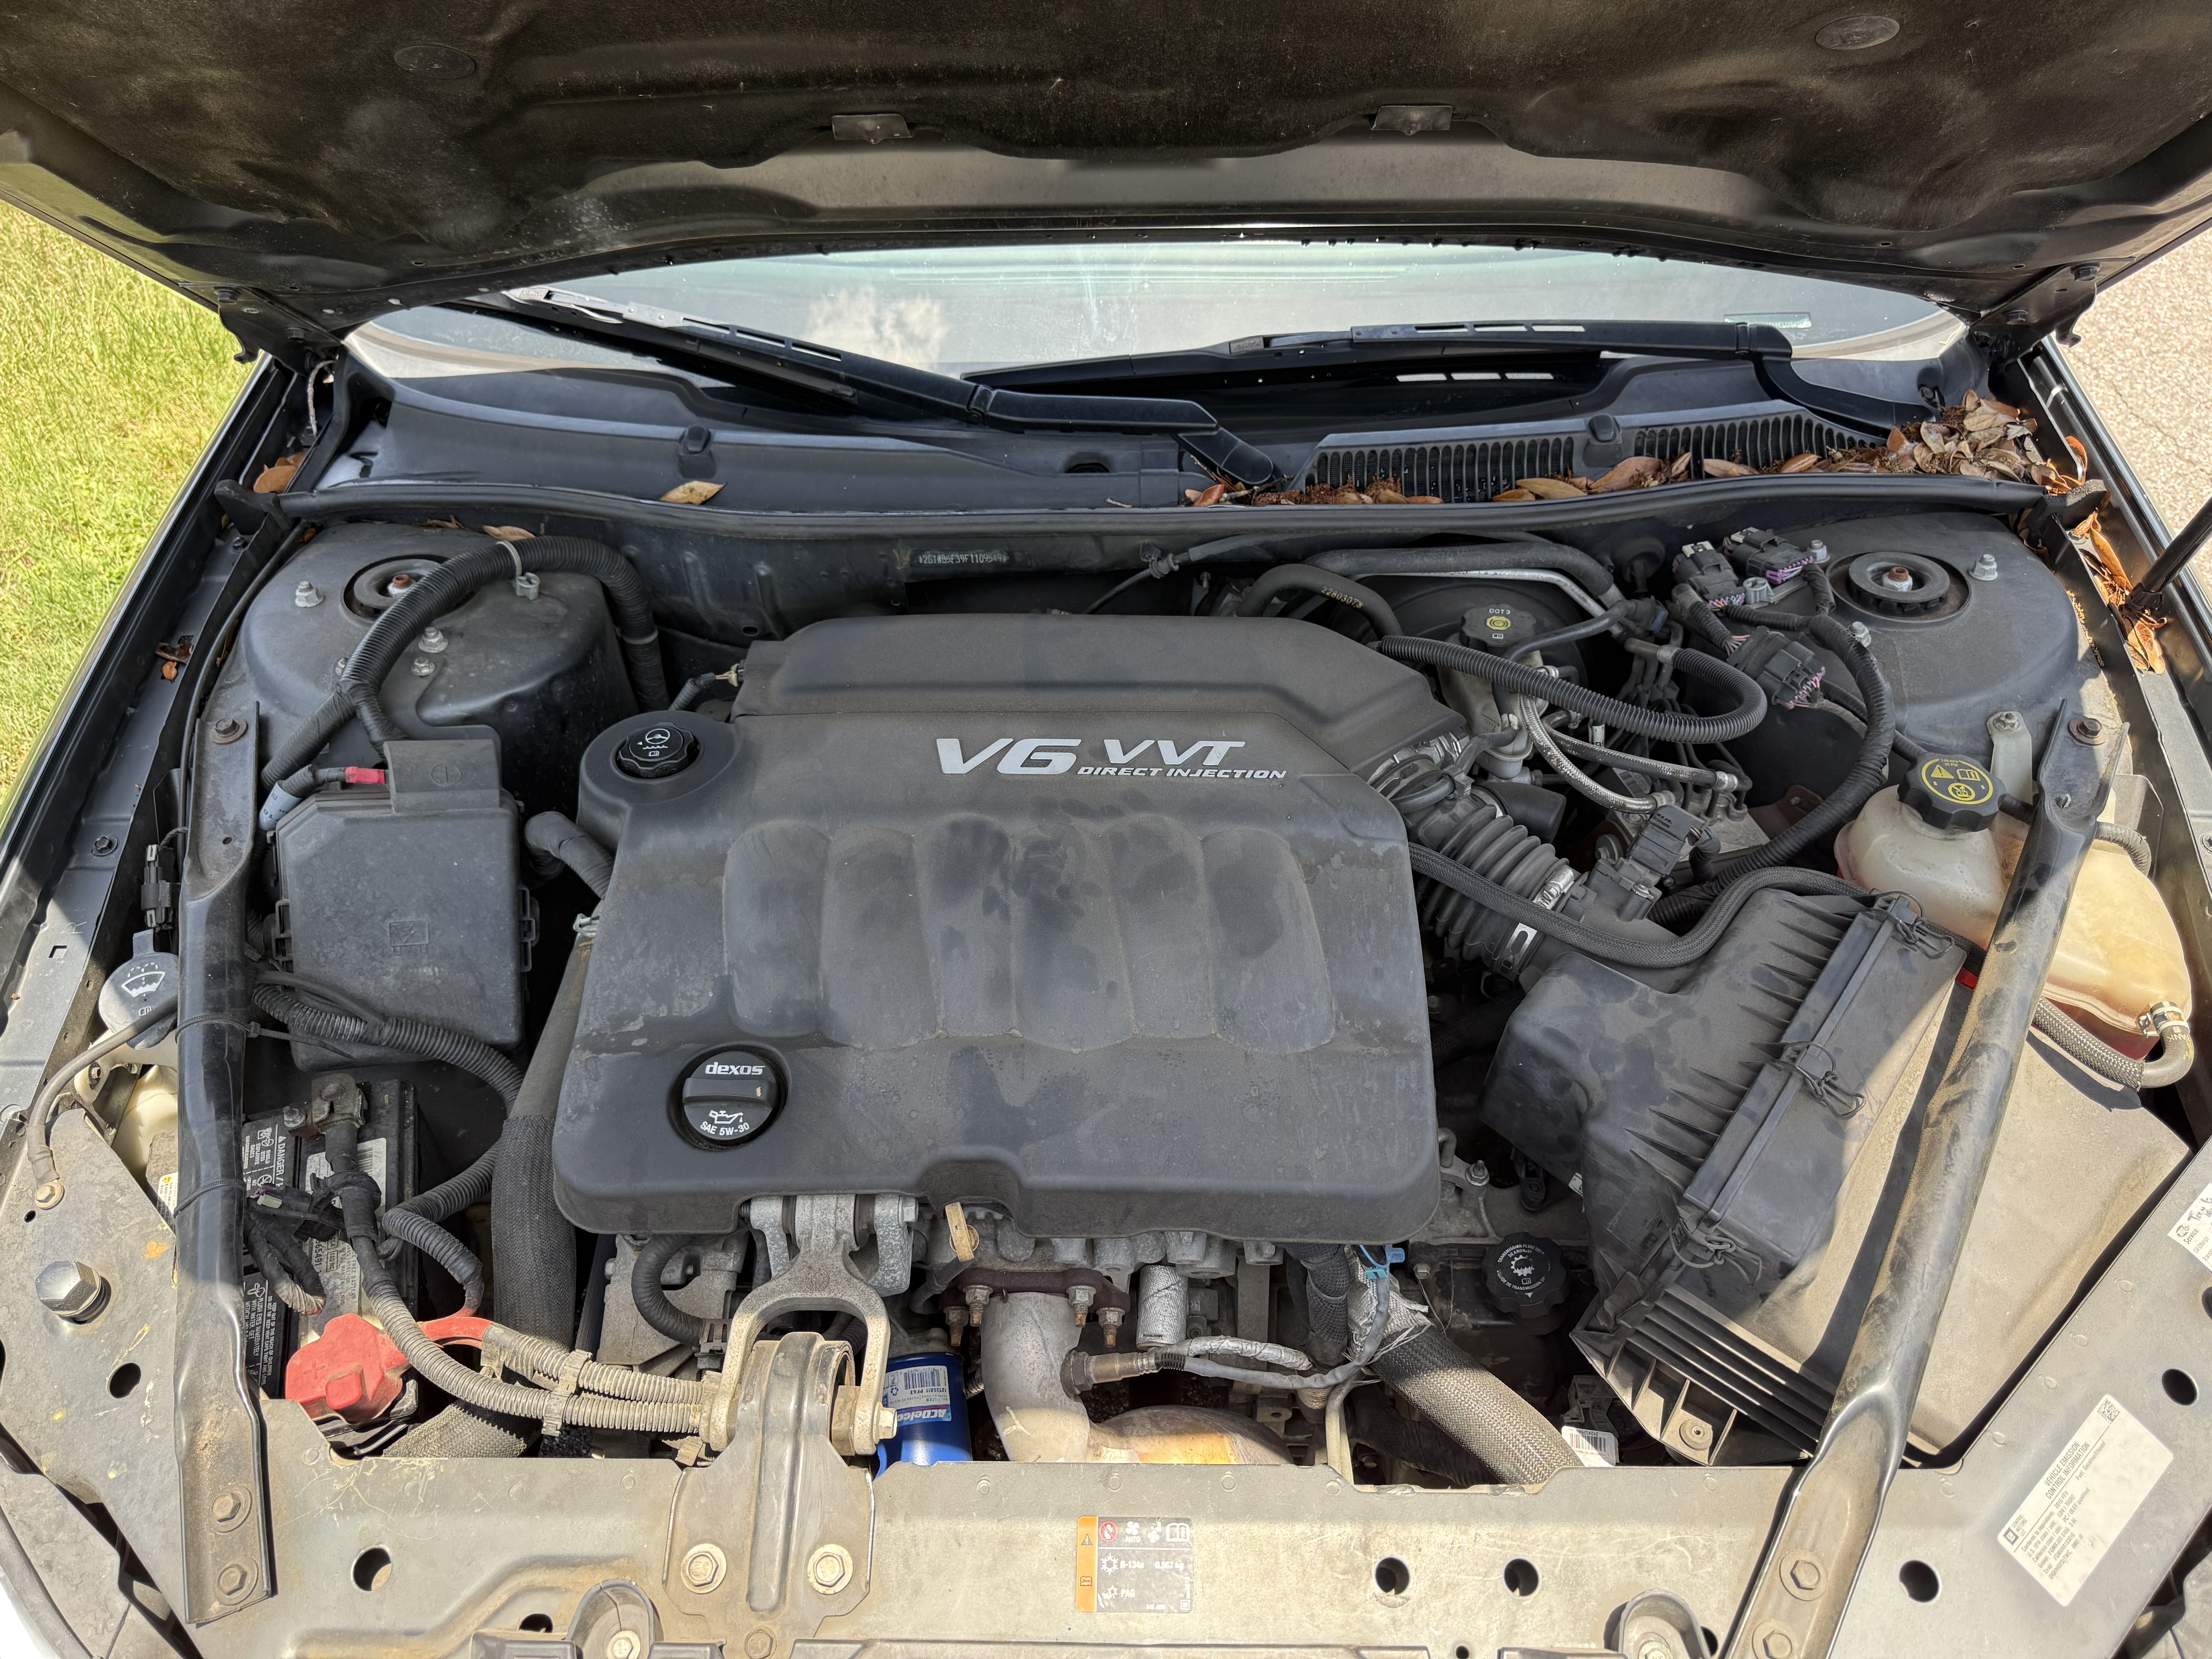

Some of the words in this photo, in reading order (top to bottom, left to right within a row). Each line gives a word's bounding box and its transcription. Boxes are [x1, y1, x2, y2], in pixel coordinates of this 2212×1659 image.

[936, 738, 1082, 775] V6
[1103, 739, 1245, 766] VVT
[1077, 766, 1163, 776] DIRECT
[1166, 768, 1287, 779] INJECTION
[705, 1061, 766, 1075] dexos
[700, 1121, 718, 1135] SAE
[719, 1122, 750, 1136] 5W-30
[276, 1143, 285, 1176] DANGER
[2184, 1228, 2199, 1244] Service
[1498, 1244, 1522, 1262] TRANSMISSION
[1512, 1281, 1542, 1290] TRANSMISSION
[252, 1326, 261, 1357] IMMEDIATELY
[2045, 1463, 2063, 1487] VEHICLE
[2060, 1441, 2080, 1467] EMISSION
[2045, 1474, 2065, 1499] CONTROL
[2063, 1441, 2090, 1477] INFORMATION
[2054, 1498, 2063, 1509] 2015
[2061, 1490, 2069, 1500] FFV
[2039, 1530, 2048, 1541] class
[2057, 1508, 2065, 1518] LDV
[2045, 1535, 2054, 1546] class
[2062, 1515, 2069, 1523] PC
[2068, 1502, 2078, 1515] ULEV
[1175, 1561, 1184, 1571] kg
[1121, 1589, 1135, 1597] PAG
